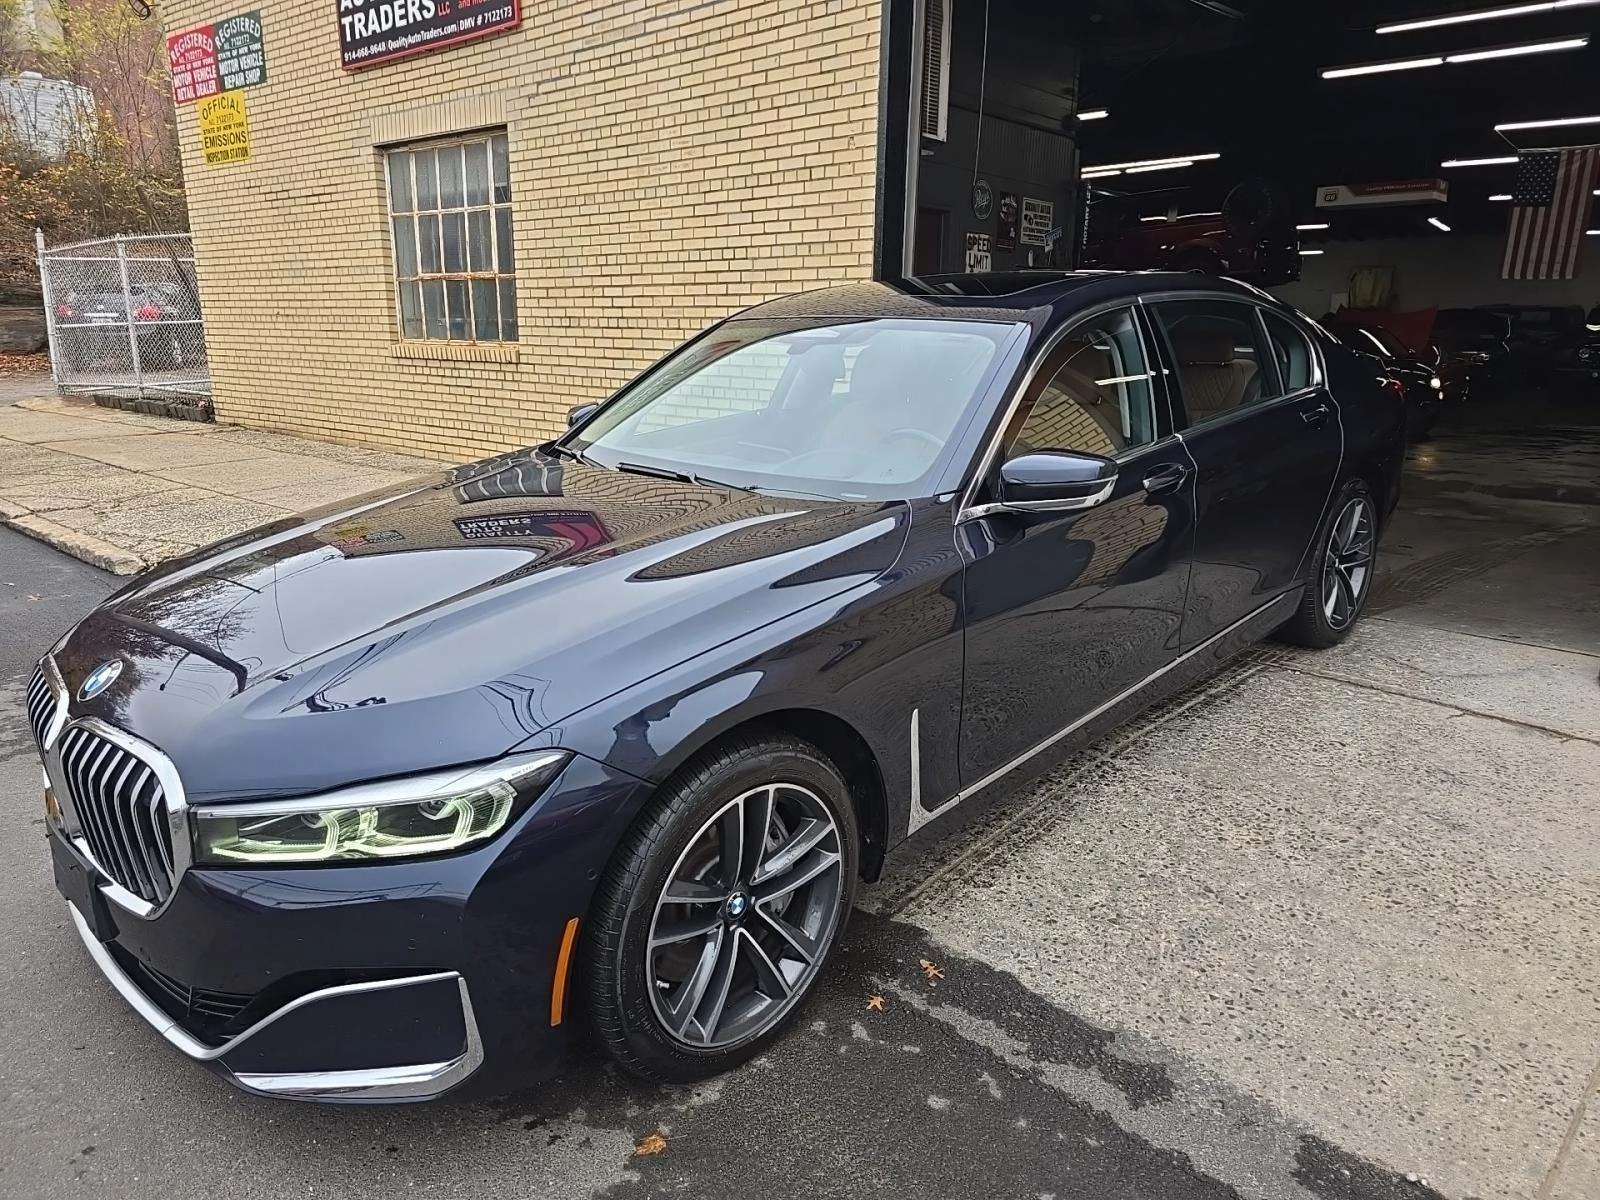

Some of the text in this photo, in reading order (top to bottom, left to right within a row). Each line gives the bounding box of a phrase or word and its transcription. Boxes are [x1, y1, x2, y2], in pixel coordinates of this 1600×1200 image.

[341, 0, 435, 42] TRADERS
[438, 1, 450, 17] LLC
[460, 16, 475, 30] DMV
[477, 14, 482, 25] #
[484, 5, 512, 24] 7122173
[215, 17, 261, 50] REGISTERED
[170, 33, 213, 64] REGISTERED
[239, 46, 248, 55] NEW
[249, 42, 261, 52] YORK
[219, 51, 263, 75] MOTOR VEHICLE
[173, 65, 217, 87] MOTOR VEHICLE
[224, 68, 260, 89] REPAIR SHOP
[177, 80, 217, 101] RETAIL DEALER
[202, 97, 241, 120] OFFICIAL
[204, 131, 247, 149] EMISSIONS
[206, 147, 249, 163] INSPECTION STATION
[967, 234, 991, 253] SPEED
[968, 252, 989, 270] LIMIT
